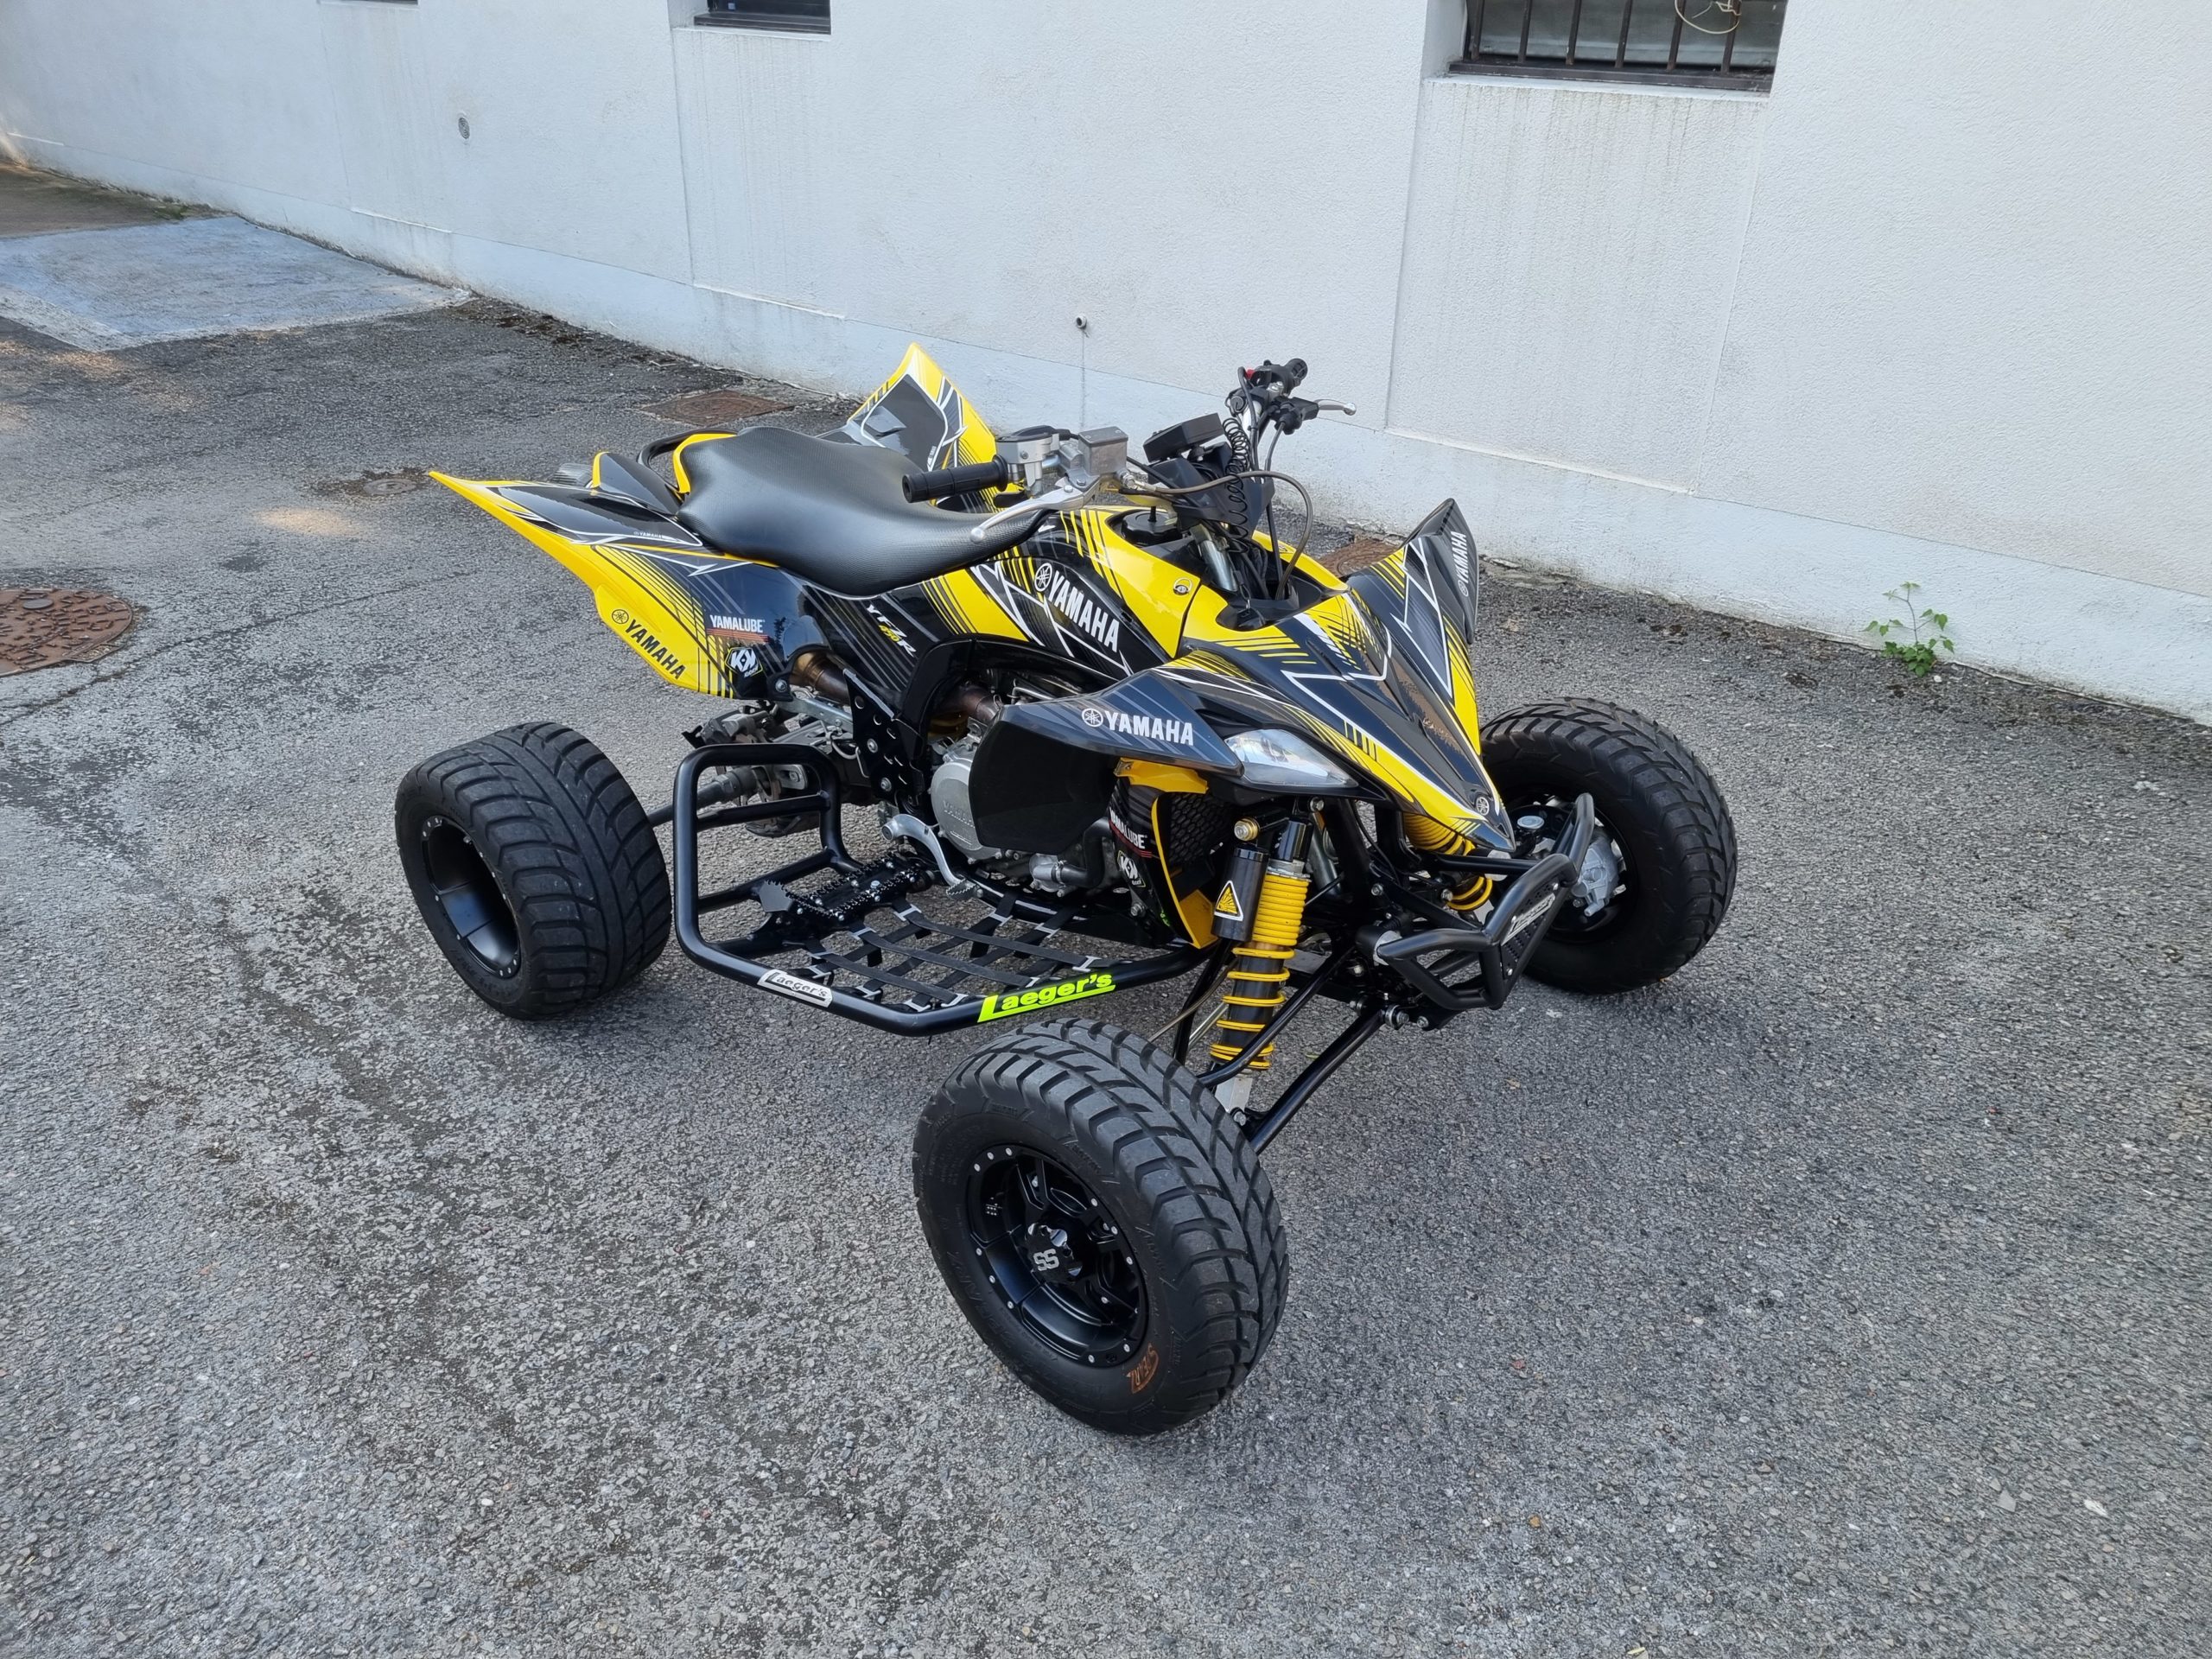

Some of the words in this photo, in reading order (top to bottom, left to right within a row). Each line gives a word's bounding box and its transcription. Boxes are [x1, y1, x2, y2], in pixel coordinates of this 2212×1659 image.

[1451, 531, 1469, 583] YAMAHA
[709, 614, 764, 633] YAMALUBE
[1048, 570, 1120, 652] YAMAHA
[625, 619, 687, 680] YAMAHA
[1104, 710, 1194, 747] YAMAHA
[977, 974, 1116, 1023] Laeger's
